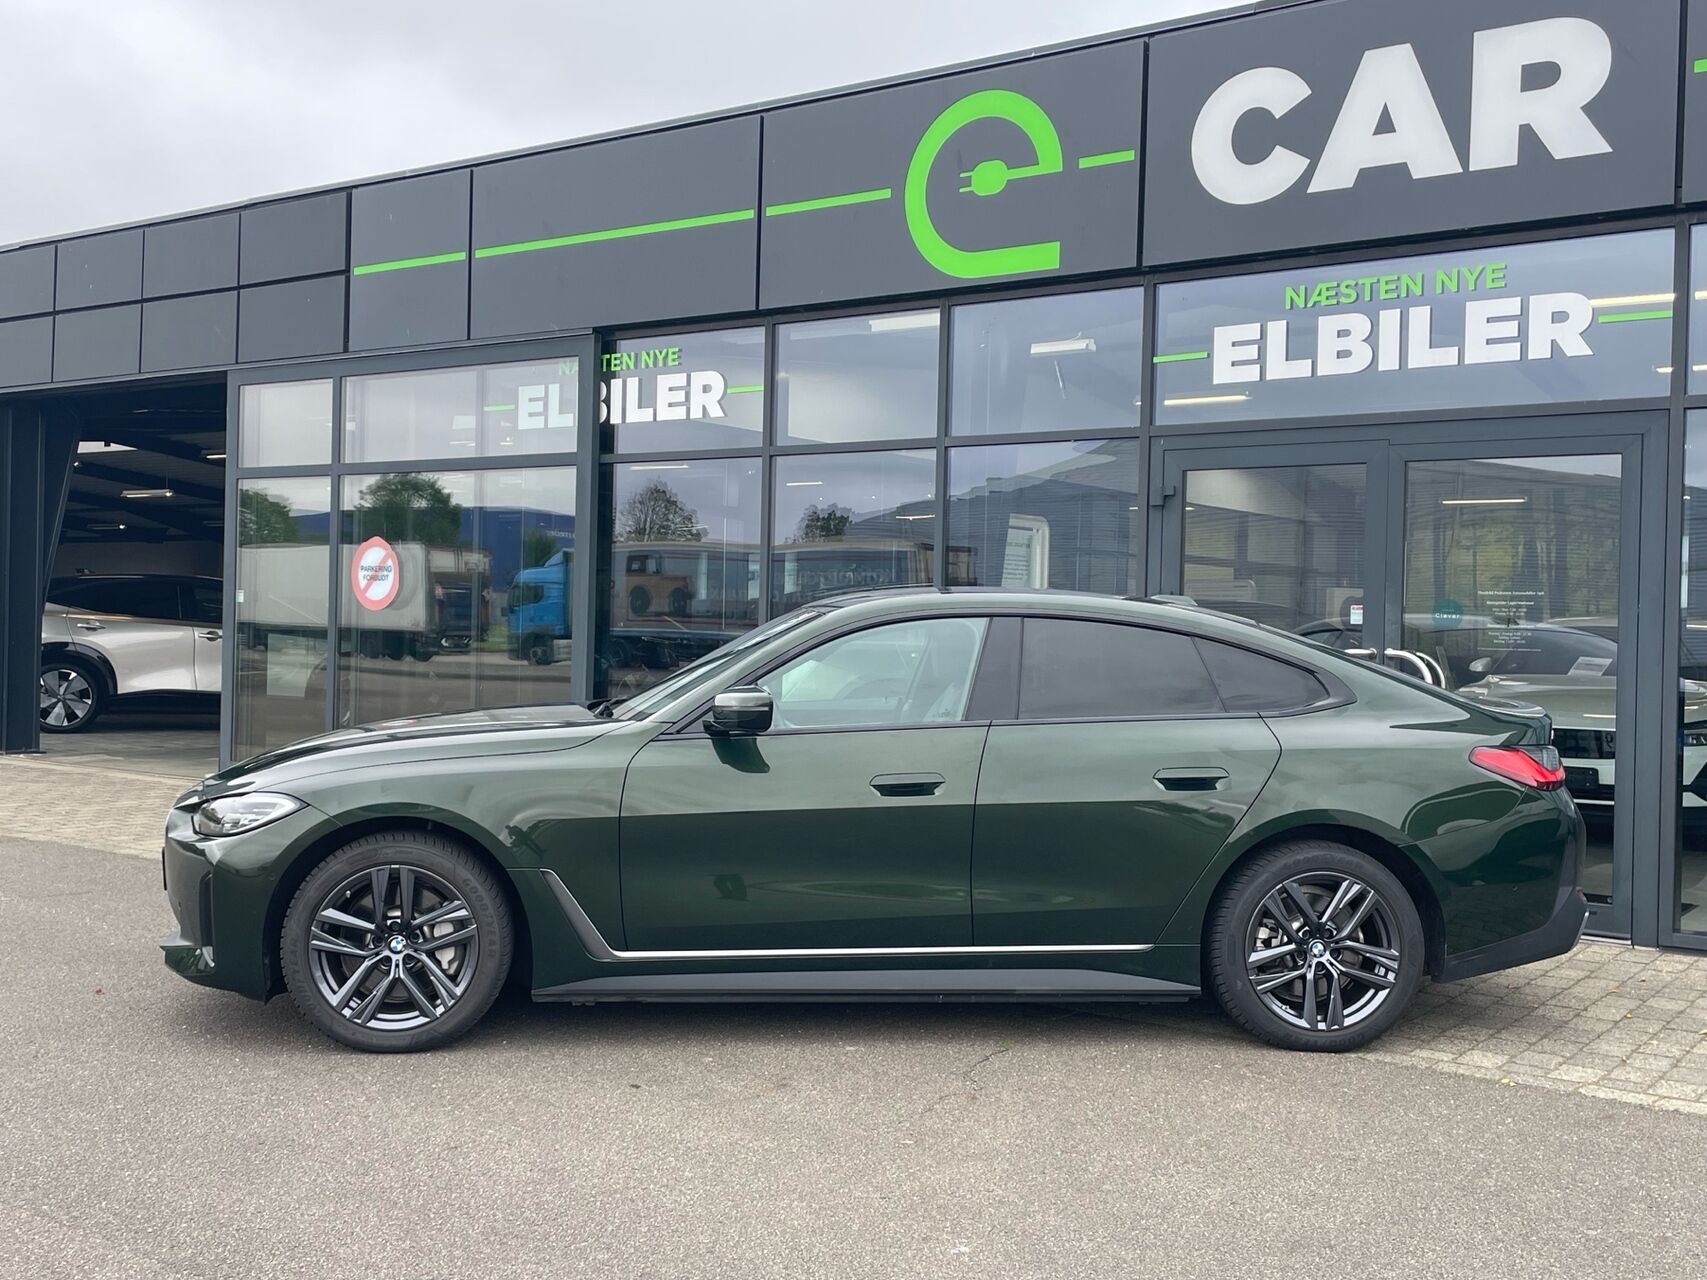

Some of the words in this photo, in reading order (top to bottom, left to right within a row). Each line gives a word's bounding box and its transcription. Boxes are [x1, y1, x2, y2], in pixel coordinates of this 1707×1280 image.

[1190, 16, 1614, 206] CAR
[1284, 268, 1425, 310] NÆSTEN
[1434, 263, 1508, 294] NYE
[1212, 292, 1595, 385] ELBILER
[640, 347, 681, 369] NYE
[360, 565, 392, 573] PARKERING
[362, 574, 389, 582] FORBUDT
